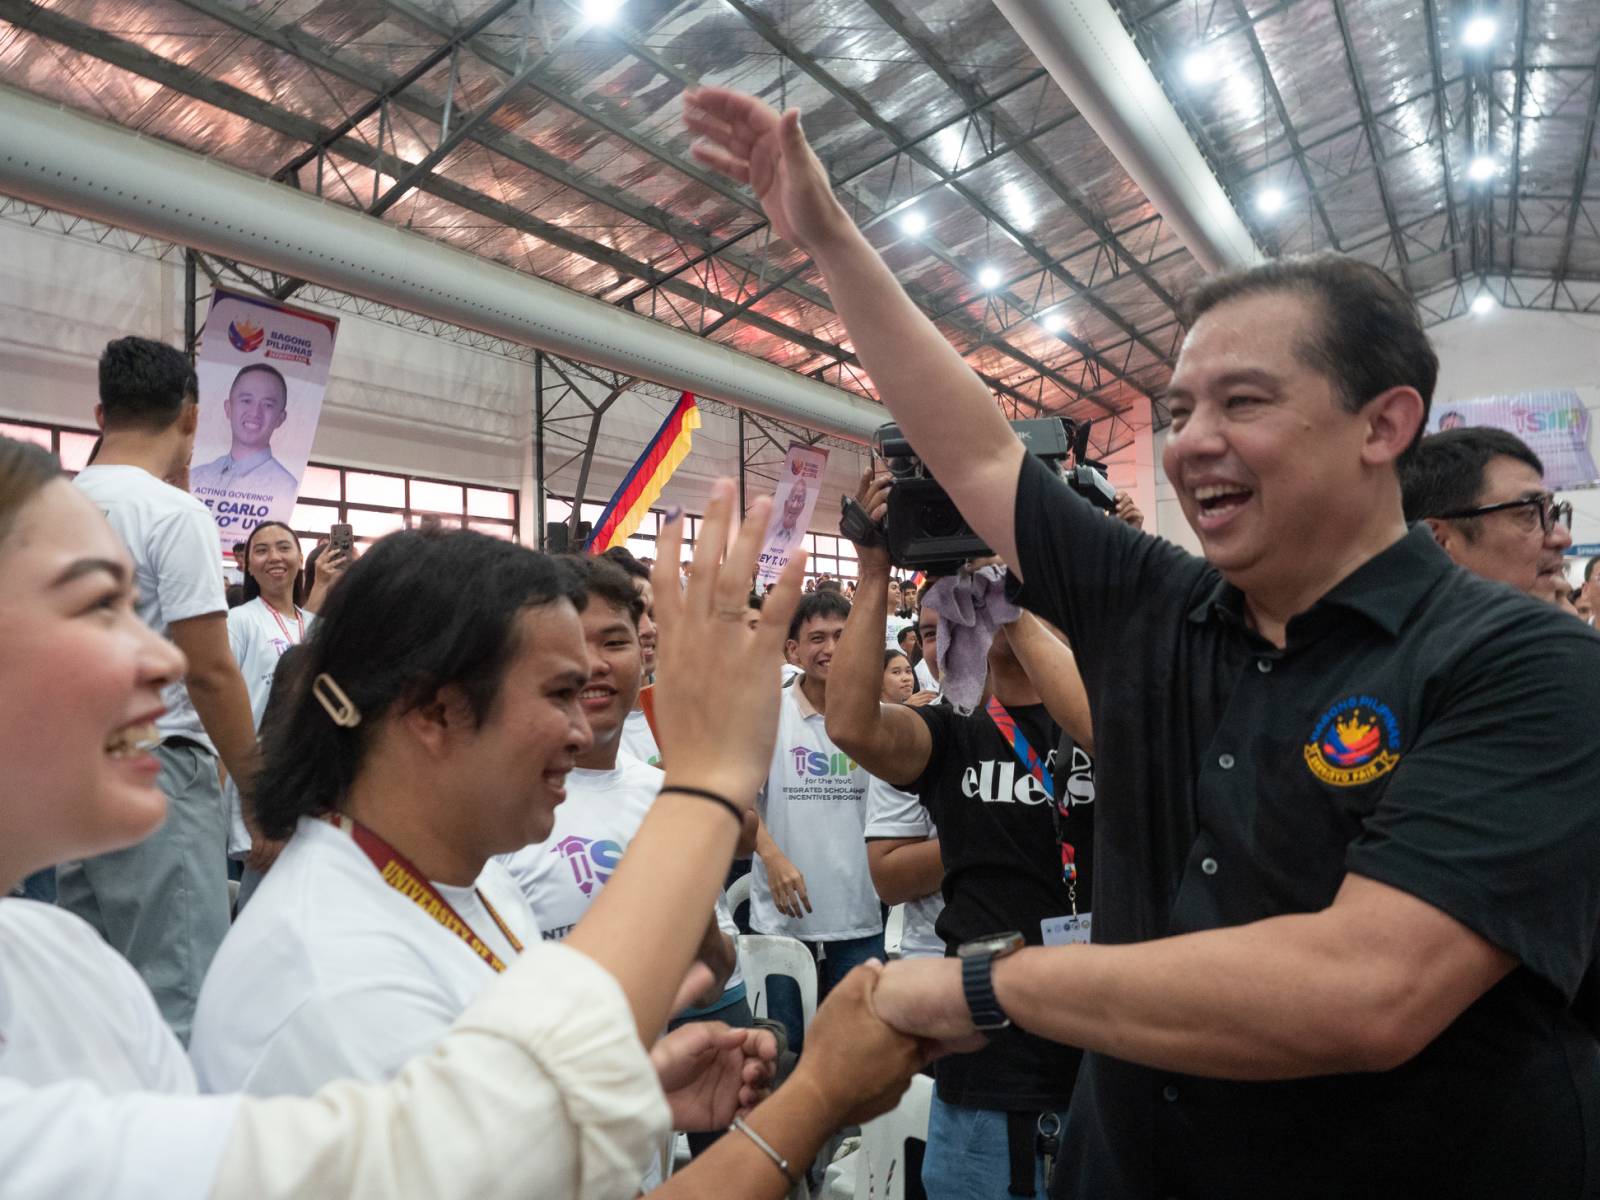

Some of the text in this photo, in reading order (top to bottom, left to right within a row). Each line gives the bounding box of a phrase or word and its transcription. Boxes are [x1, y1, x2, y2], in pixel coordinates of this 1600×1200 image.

[266, 339, 312, 357] PILIPINAS
[270, 331, 311, 348] BAGONG
[194, 486, 274, 502] ACTING GOVERNOR
[217, 501, 269, 517] CARLO
[382, 859, 470, 940] UNIVERSITY
[470, 938, 489, 957] OF
